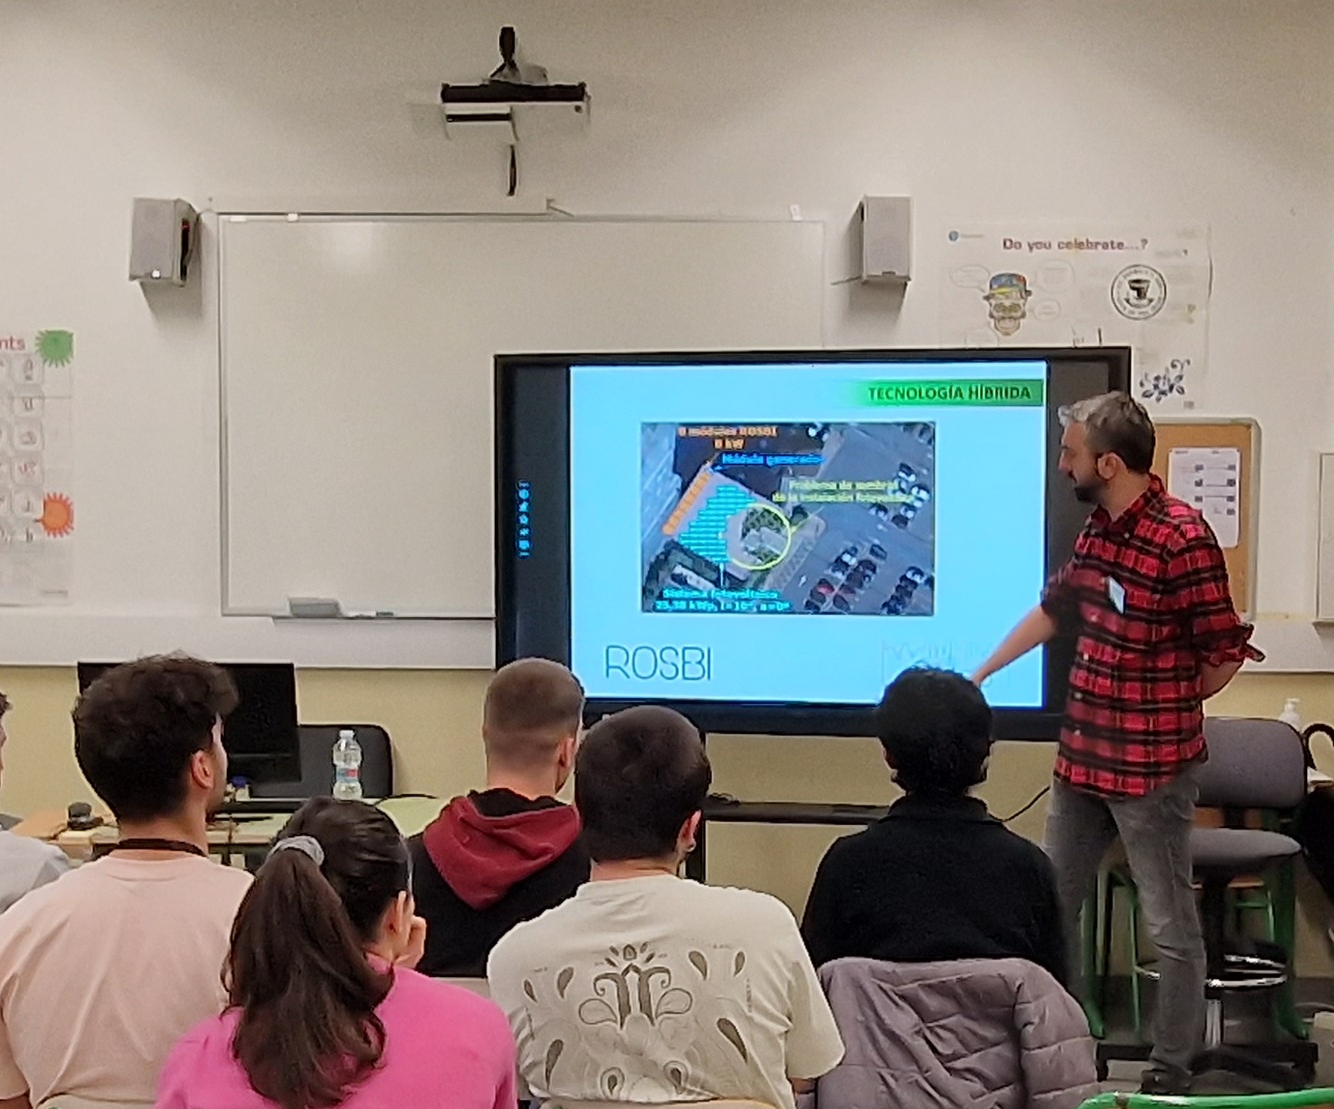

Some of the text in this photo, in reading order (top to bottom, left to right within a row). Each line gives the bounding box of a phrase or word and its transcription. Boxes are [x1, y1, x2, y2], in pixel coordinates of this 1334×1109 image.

[1003, 238, 1022, 250] Do
[1027, 240, 1052, 253] you
[869, 384, 1031, 400] TECNOLOGÍA HÍBRIDA
[605, 645, 711, 681] ROSBI
